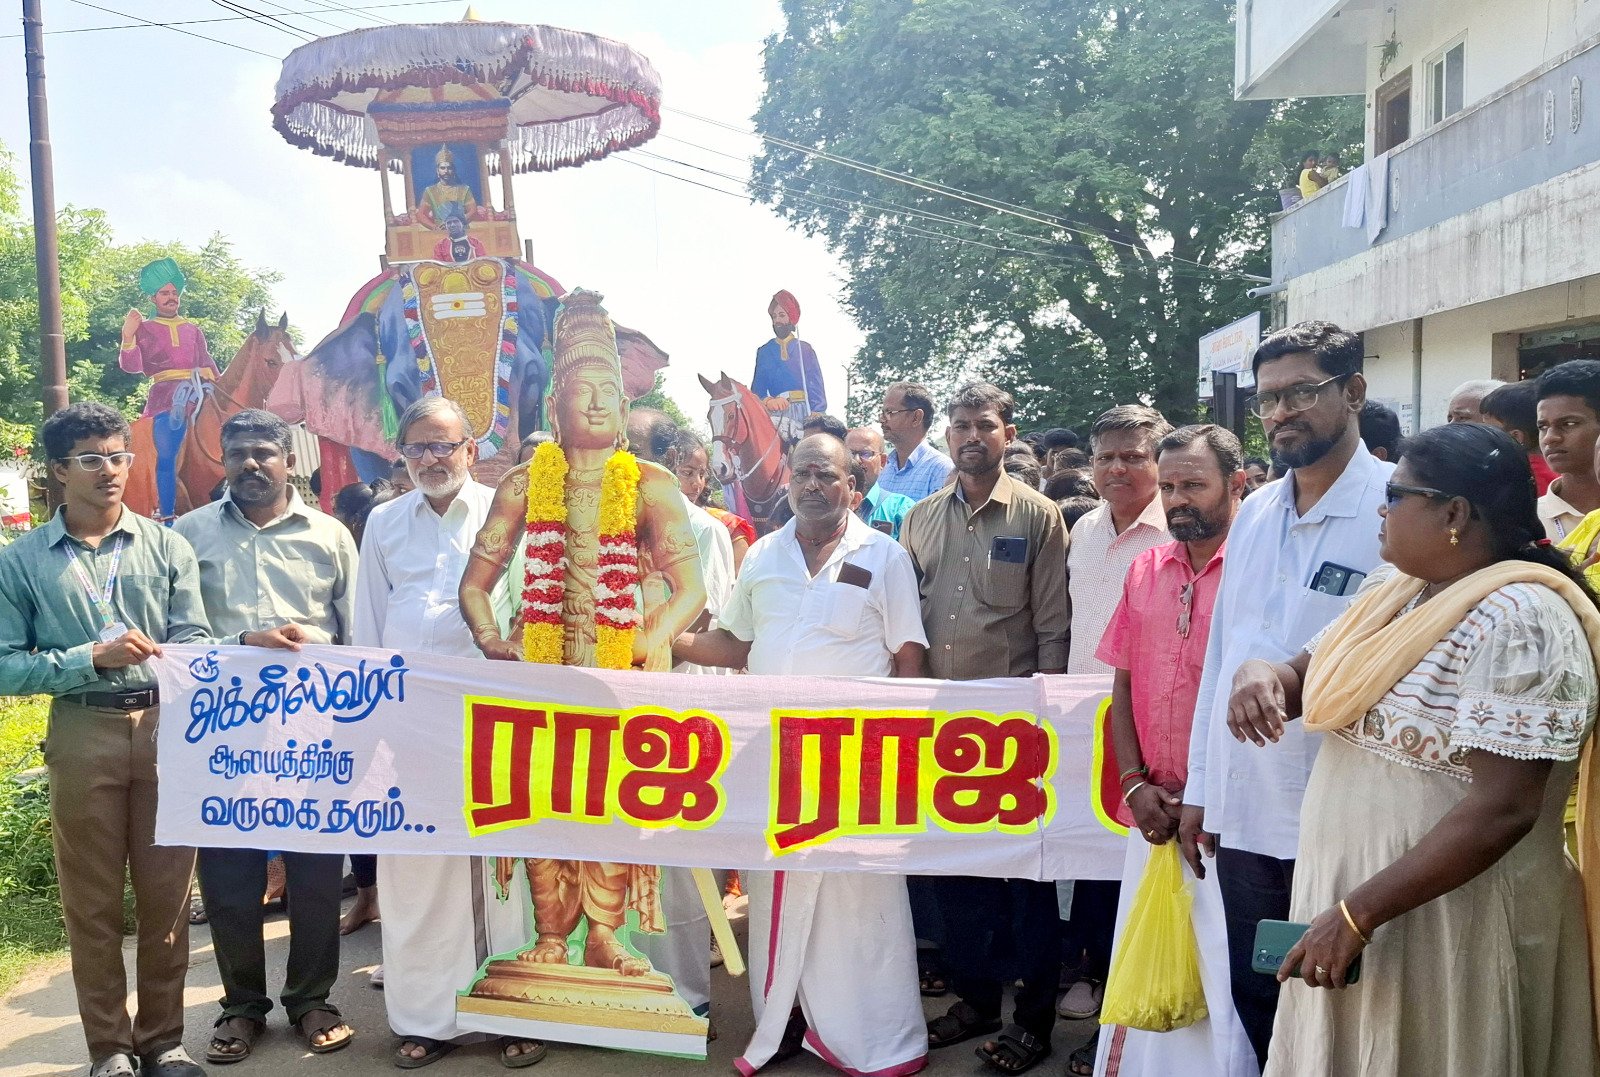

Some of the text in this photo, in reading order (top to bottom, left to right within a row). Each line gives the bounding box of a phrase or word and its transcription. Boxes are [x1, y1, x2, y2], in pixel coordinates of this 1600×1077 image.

[185, 654, 410, 744] அக்னீஸ்வரர்
[189, 650, 219, 683] ஸ்ரீ
[208, 738, 354, 785] ஆலயத்திற்கு
[468, 701, 724, 830] ராஜ
[771, 713, 1052, 851] ராஜ
